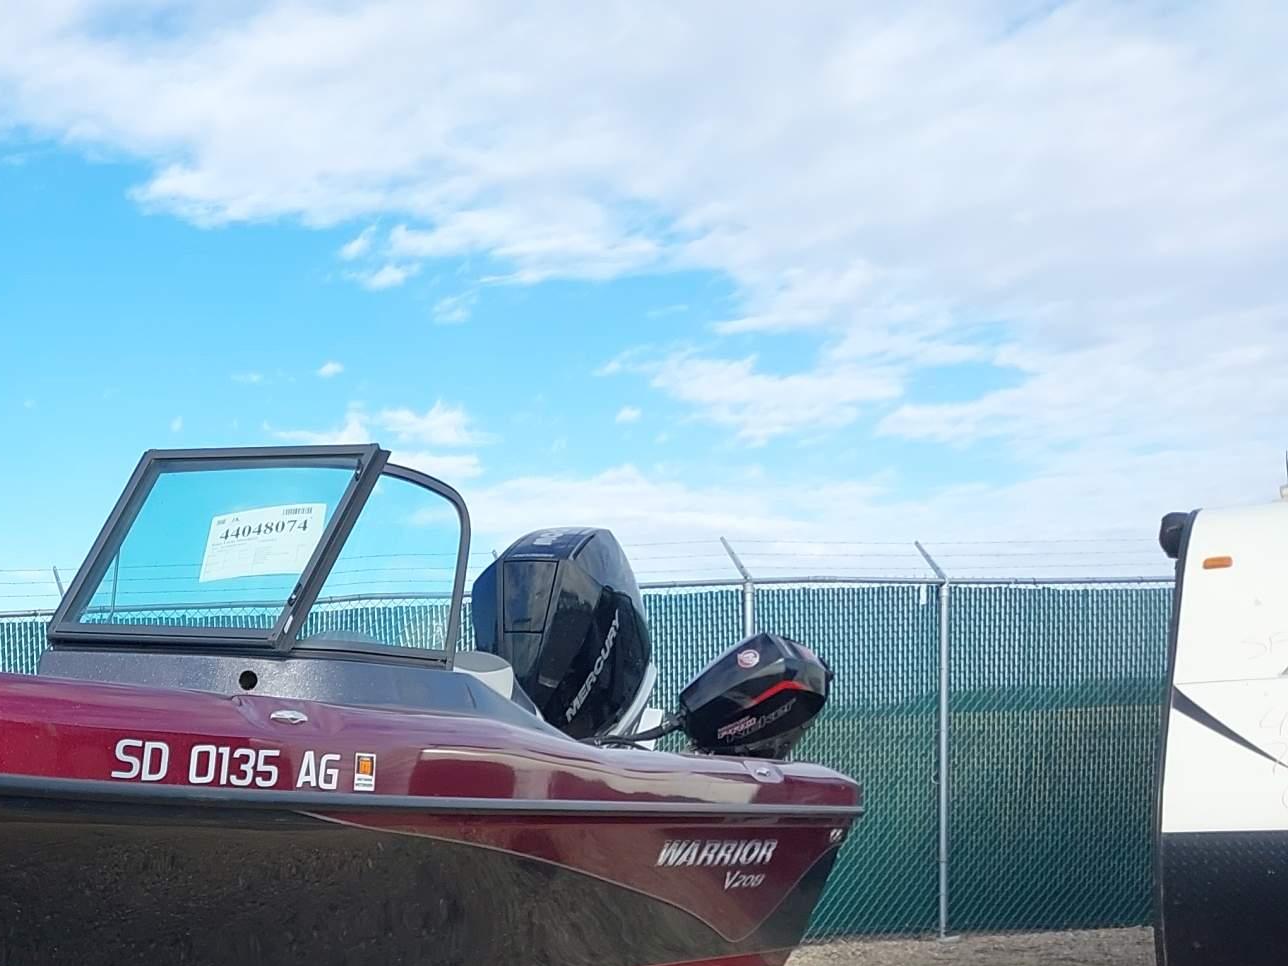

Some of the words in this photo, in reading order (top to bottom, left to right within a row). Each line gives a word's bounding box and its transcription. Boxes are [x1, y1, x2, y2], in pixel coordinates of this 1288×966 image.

[219, 519, 308, 541] 44048074
[566, 608, 619, 722] MERCURY
[111, 738, 169, 782] SD
[188, 744, 281, 788] 0135
[296, 750, 341, 790] AG
[656, 839, 778, 867] WARRIOR
